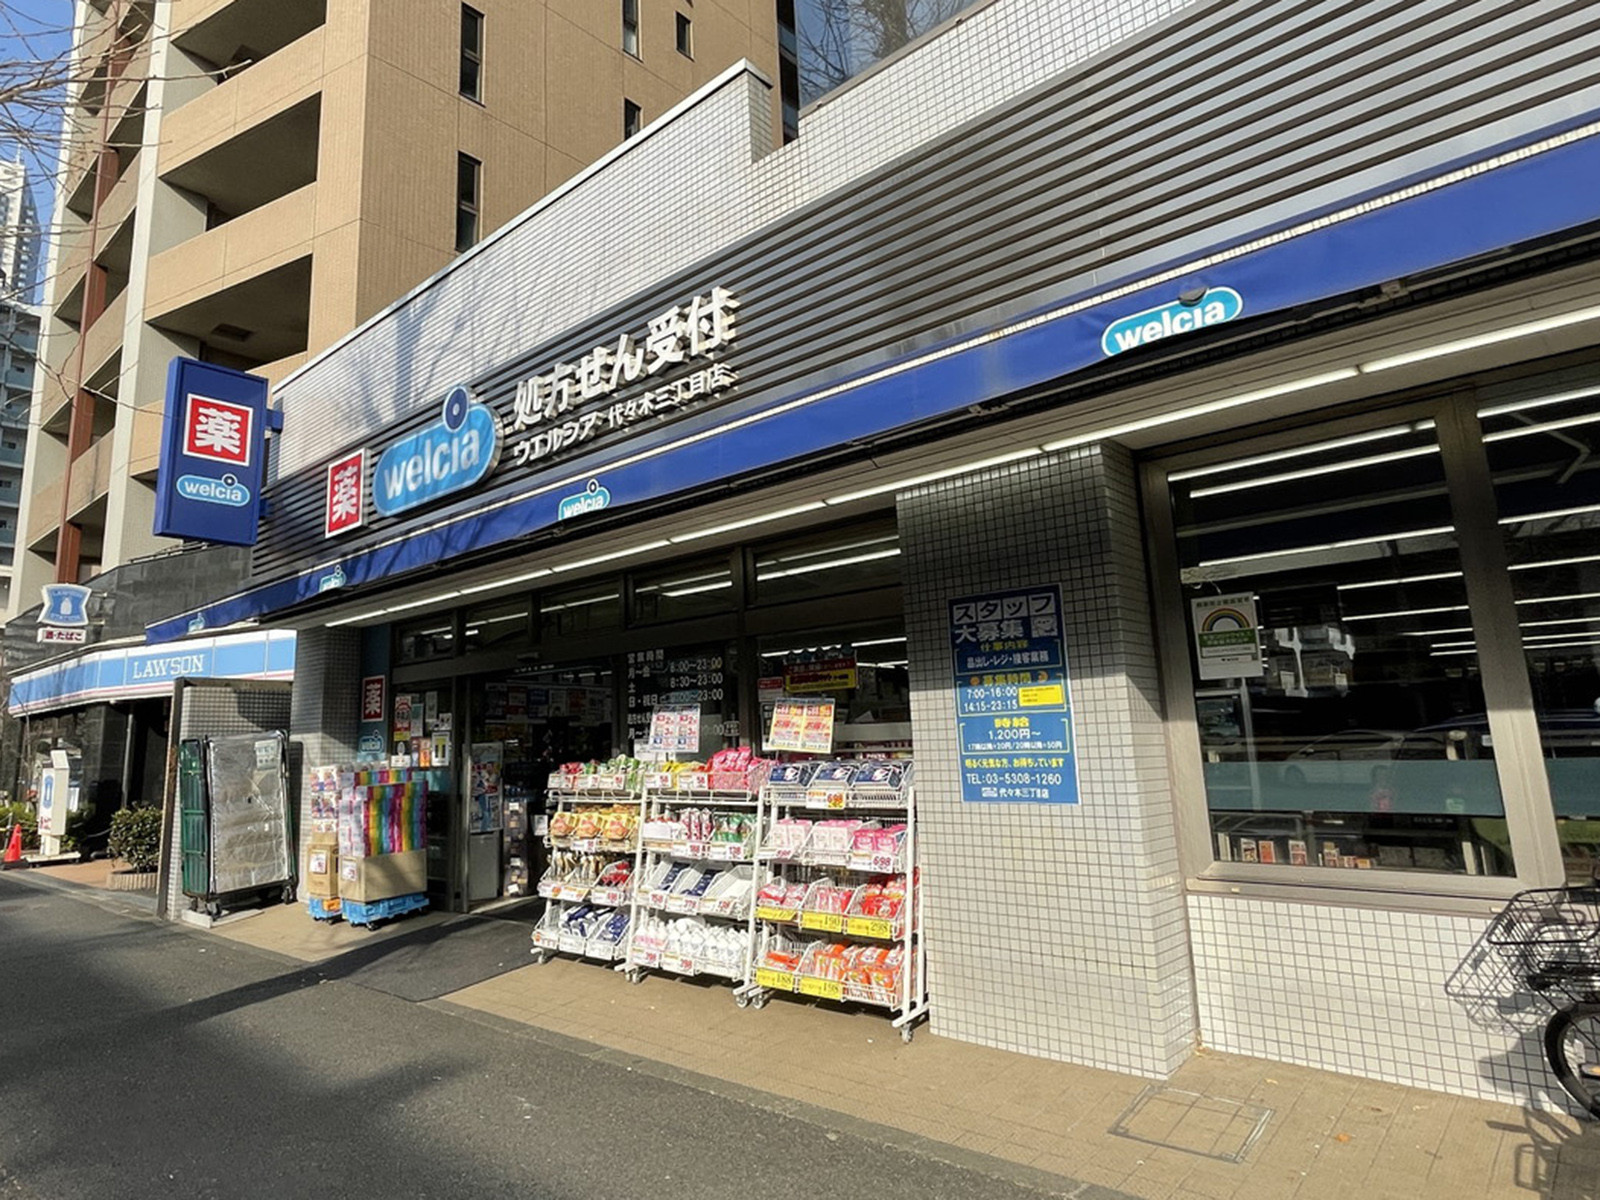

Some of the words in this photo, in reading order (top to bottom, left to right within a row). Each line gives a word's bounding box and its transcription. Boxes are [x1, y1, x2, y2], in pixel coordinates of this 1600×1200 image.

[1114, 301, 1226, 351] welcia
[514, 286, 735, 429] 処方せん受付
[195, 407, 241, 454] 薬
[513, 412, 600, 466] ウエルシア
[608, 363, 733, 428] 代々木三丁目店
[384, 429, 480, 500] welcia
[185, 481, 242, 502] welcia
[332, 465, 358, 523] 薬
[563, 495, 604, 518] welcia
[955, 595, 1052, 622] スタッフ
[955, 620, 1024, 643] 大募集
[132, 654, 204, 680] LAWSON
[365, 682, 381, 715] 薬
[873, 856, 891, 866] 698
